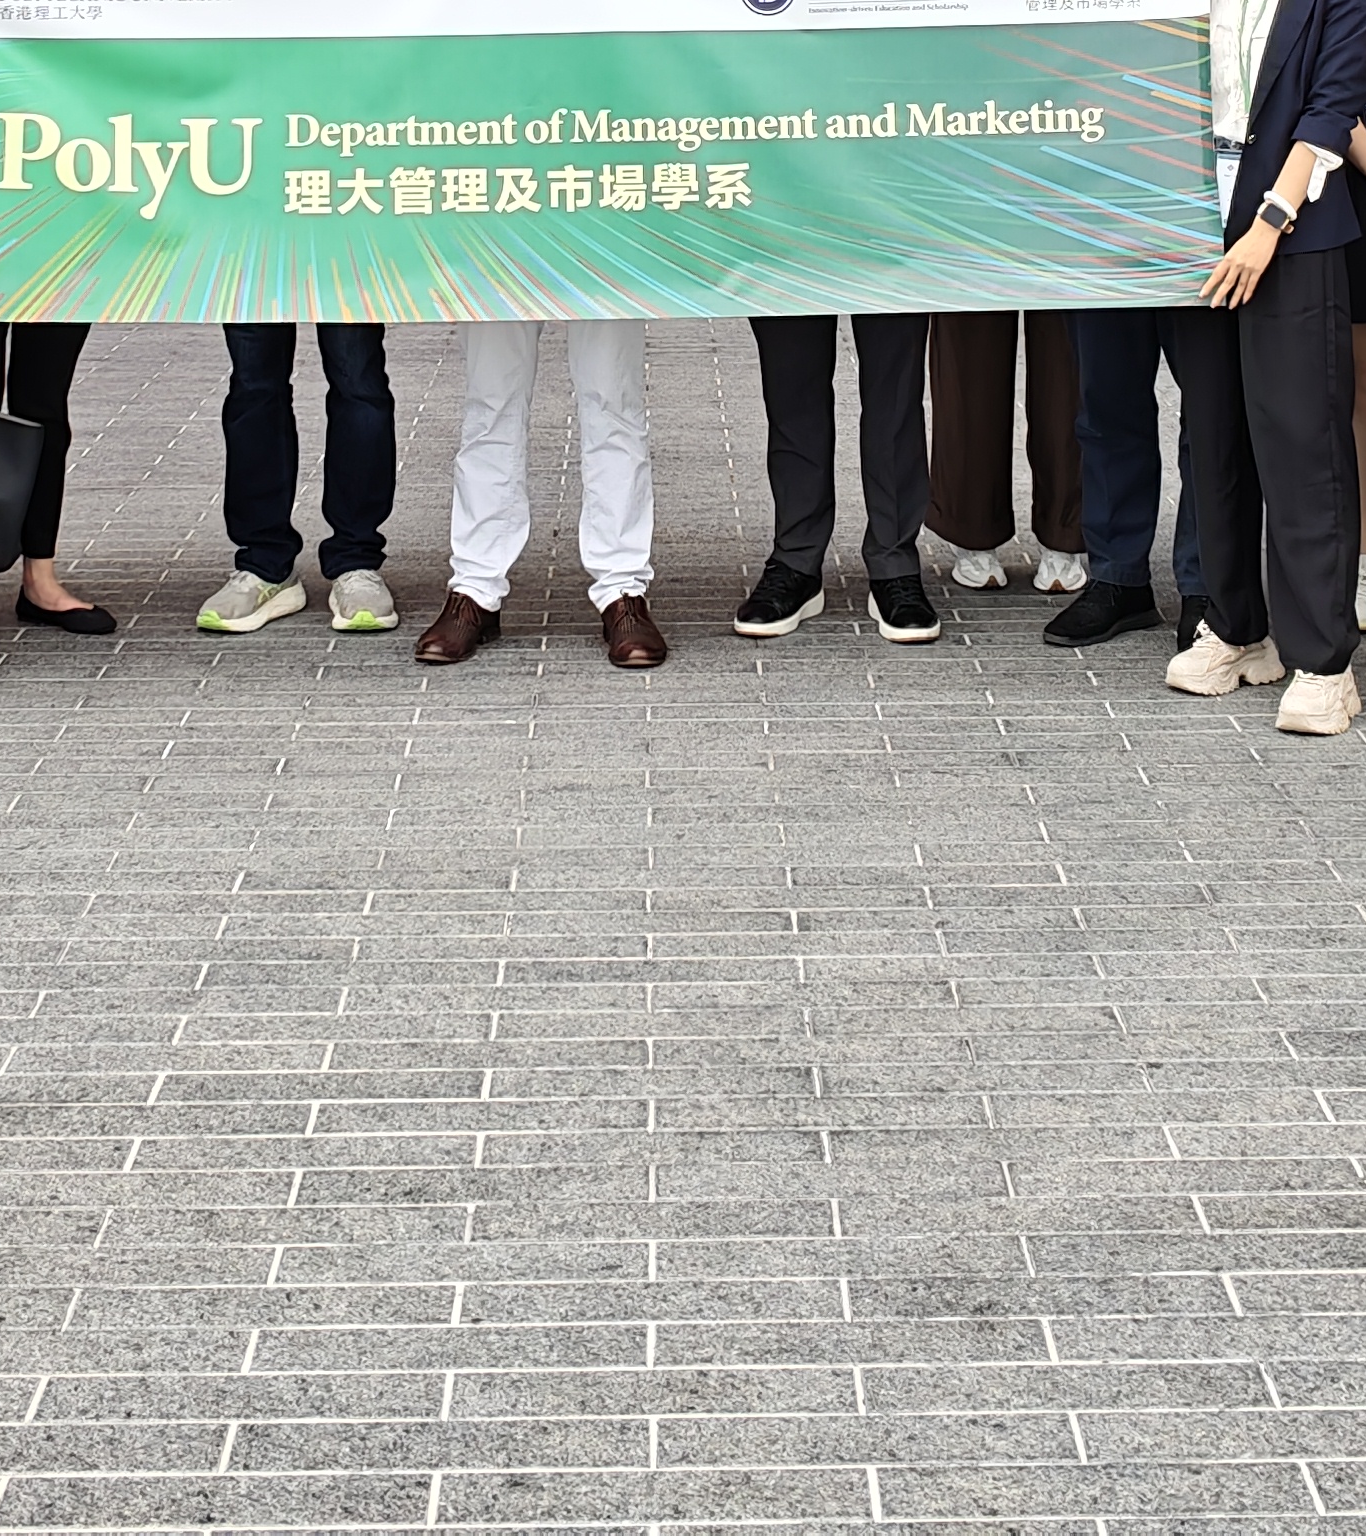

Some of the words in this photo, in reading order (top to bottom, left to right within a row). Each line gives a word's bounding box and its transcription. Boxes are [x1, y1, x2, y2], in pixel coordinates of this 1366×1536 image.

[284, 113, 518, 158] Department
[524, 108, 566, 144] of
[569, 107, 819, 152] Management
[825, 102, 898, 140] and
[905, 99, 1106, 143] Marketing
[284, 162, 753, 216] 理大管理及市場學系
